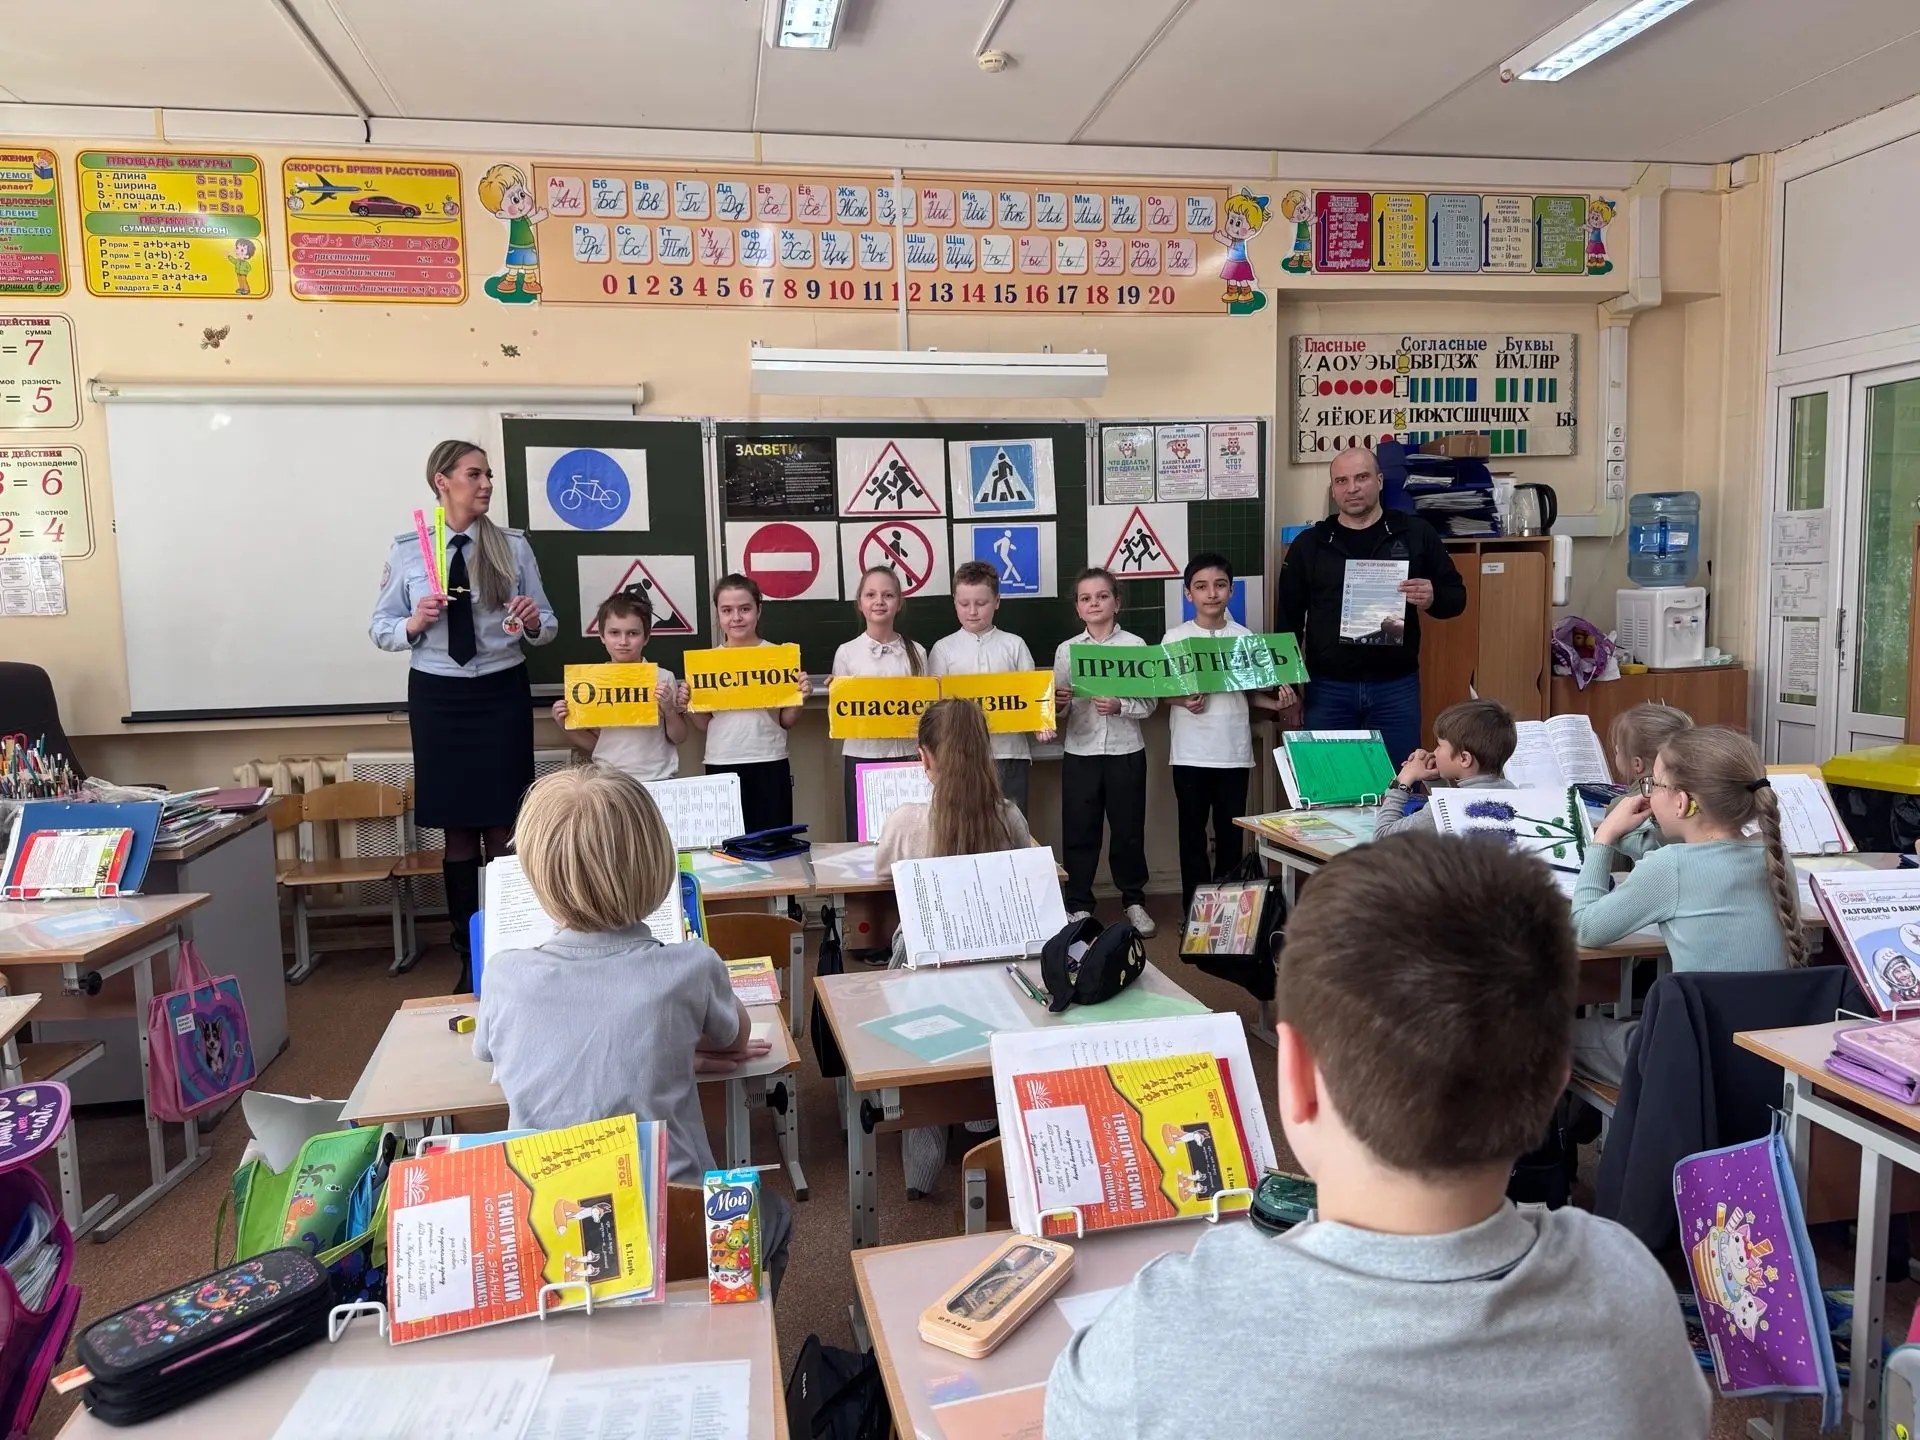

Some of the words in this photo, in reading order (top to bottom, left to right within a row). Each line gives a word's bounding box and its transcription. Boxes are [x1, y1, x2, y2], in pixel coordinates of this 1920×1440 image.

[106, 157, 172, 167] ПЛОЩАДЬ
[177, 159, 232, 169] ФИГУРЫ
[287, 164, 343, 173] СКОРОСТЬ
[346, 166, 383, 174] ВРЕМЯ
[385, 167, 456, 177] РАССТОЯНИЕ
[549, 178, 565, 189] Аа
[592, 179, 608, 189] Бб
[634, 180, 649, 190] Вв
[675, 181, 688, 192] Гг
[716, 183, 732, 194] Дд
[758, 184, 771, 194] Ее
[798, 184, 811, 196] Ёё
[838, 187, 856, 196] Жж
[878, 188, 889, 198] Зз
[924, 189, 937, 199] Ии
[962, 189, 976, 201] Йй
[1000, 192, 1012, 201] Кк
[1037, 193, 1050, 203] Лл
[1074, 194, 1090, 204] Мм
[1111, 195, 1125, 204] Нн
[1147, 196, 1161, 206] Оо
[1187, 197, 1200, 206] Пп
[574, 226, 590, 237] Рр
[616, 226, 631, 236] Сс
[659, 227, 671, 238] Тт
[700, 229, 714, 241] Уу
[741, 230, 760, 241] Фф
[781, 231, 794, 241] Хх
[821, 232, 836, 244] Цц
[861, 234, 874, 243] Чч
[906, 234, 926, 243] Шш
[946, 235, 965, 246] Щщ
[1094, 239, 1107, 248] Ээ
[1131, 240, 1150, 249] Юю
[1167, 240, 1180, 250] Яя
[603, 274, 618, 294] 0
[627, 275, 638, 295] 1
[647, 275, 660, 295] 2
[670, 276, 683, 296] 3
[693, 276, 708, 296] 4
[717, 277, 731, 297] 5
[739, 278, 753, 298] 6
[763, 278, 775, 298] 7
[784, 279, 797, 299] 8
[806, 279, 820, 300] 9
[829, 280, 855, 300] 10
[863, 281, 884, 301] 11
[930, 283, 953, 303] 13
[962, 283, 985, 303] 14
[994, 284, 1017, 303] 15
[1025, 284, 1048, 304] 16
[1057, 285, 1078, 304] 17
[1086, 285, 1109, 305] 18
[1117, 285, 1140, 305] 19
[1148, 286, 1176, 306] 20
[25, 340, 44, 365] 7
[1304, 338, 1366, 352] Гласные
[1402, 336, 1487, 352] Согласные
[1506, 336, 1554, 354] Буквы
[32, 387, 54, 413] 5
[11, 450, 62, 458] ДЕЙСТВИЯ
[42, 469, 63, 495] 6
[43, 517, 64, 542] 4
[572, 682, 649, 707] Один
[693, 667, 800, 691] щелчок
[1842, 907, 1890, 915] РАЗГОВОРЫ
[28, 1110, 53, 1128] cat
[1113, 1111, 1146, 1210] ТЕМАТИЧЕСКИЙ
[708, 1191, 747, 1216] Мой
[496, 1190, 522, 1304] ТЕМАТИЧЕСКИЙ
